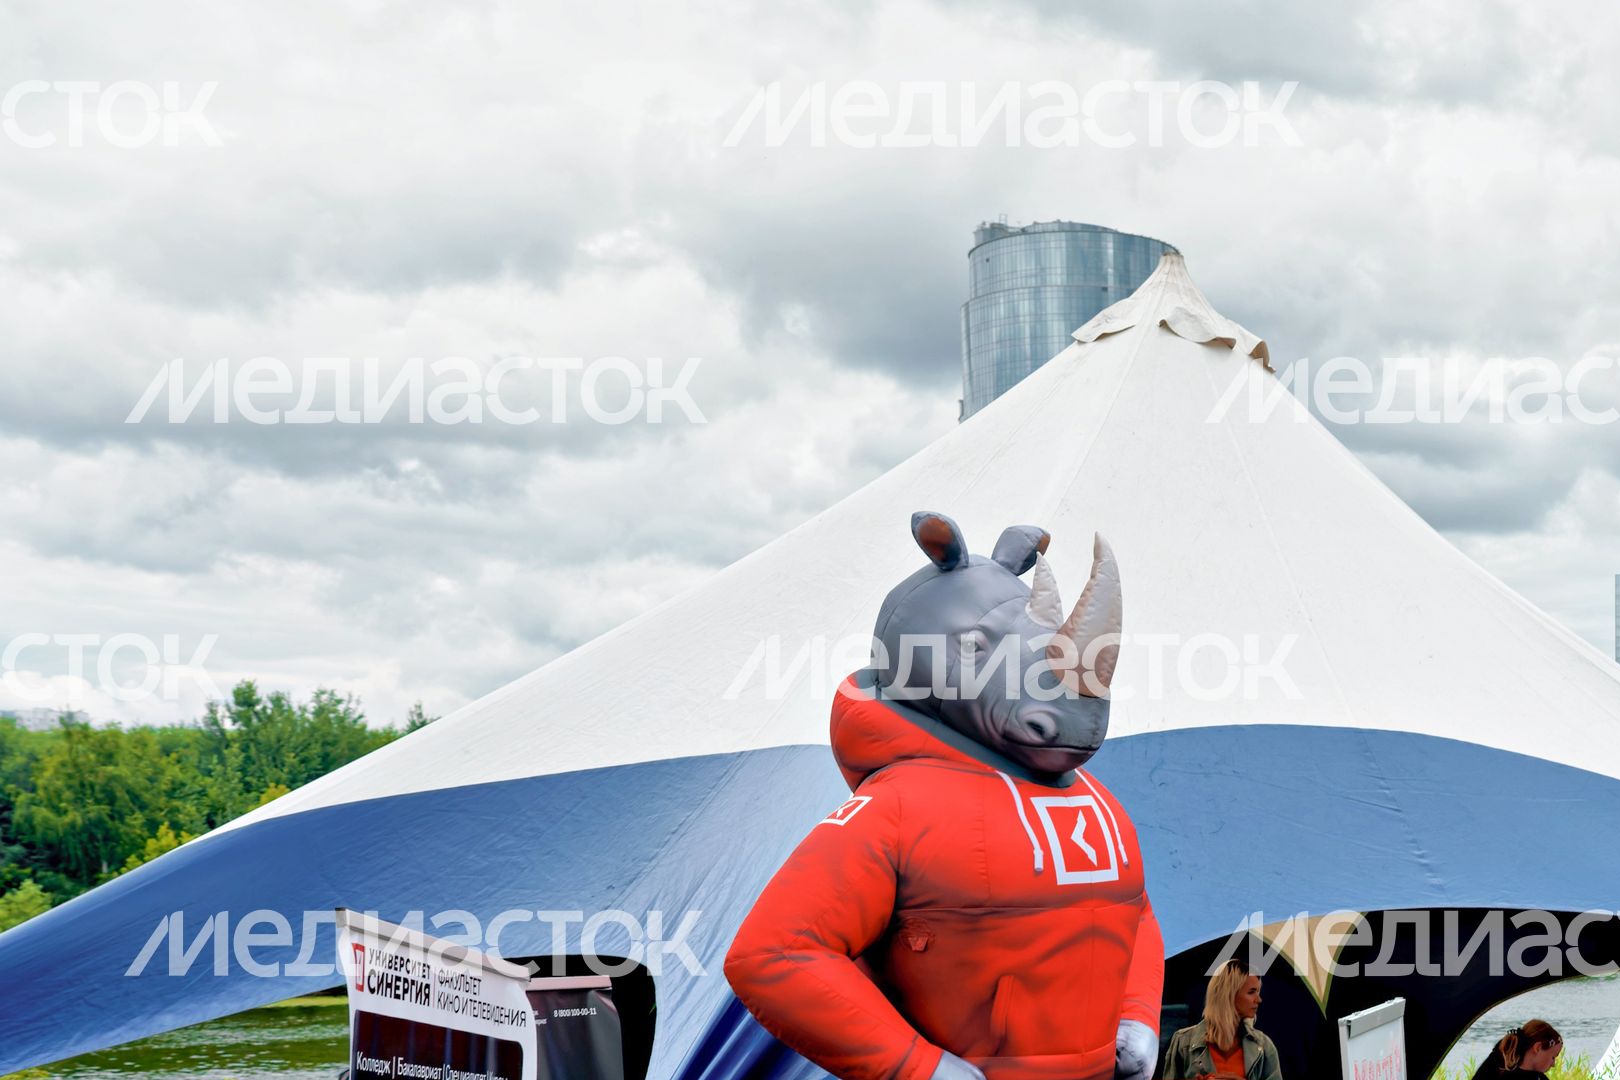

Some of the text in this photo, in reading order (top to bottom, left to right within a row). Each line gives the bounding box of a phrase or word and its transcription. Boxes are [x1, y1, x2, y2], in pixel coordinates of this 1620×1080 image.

[369, 948, 430, 979] УНИВЕРСИТЕТ
[367, 969, 430, 1006] СИНЕРГИЯ
[438, 969, 481, 996] ФАКУЛЬТЕТ
[437, 991, 460, 1013] КИНО
[468, 999, 527, 1027] ТЕЛЕВИДЕНИЯ
[356, 1051, 391, 1076] Колледж
